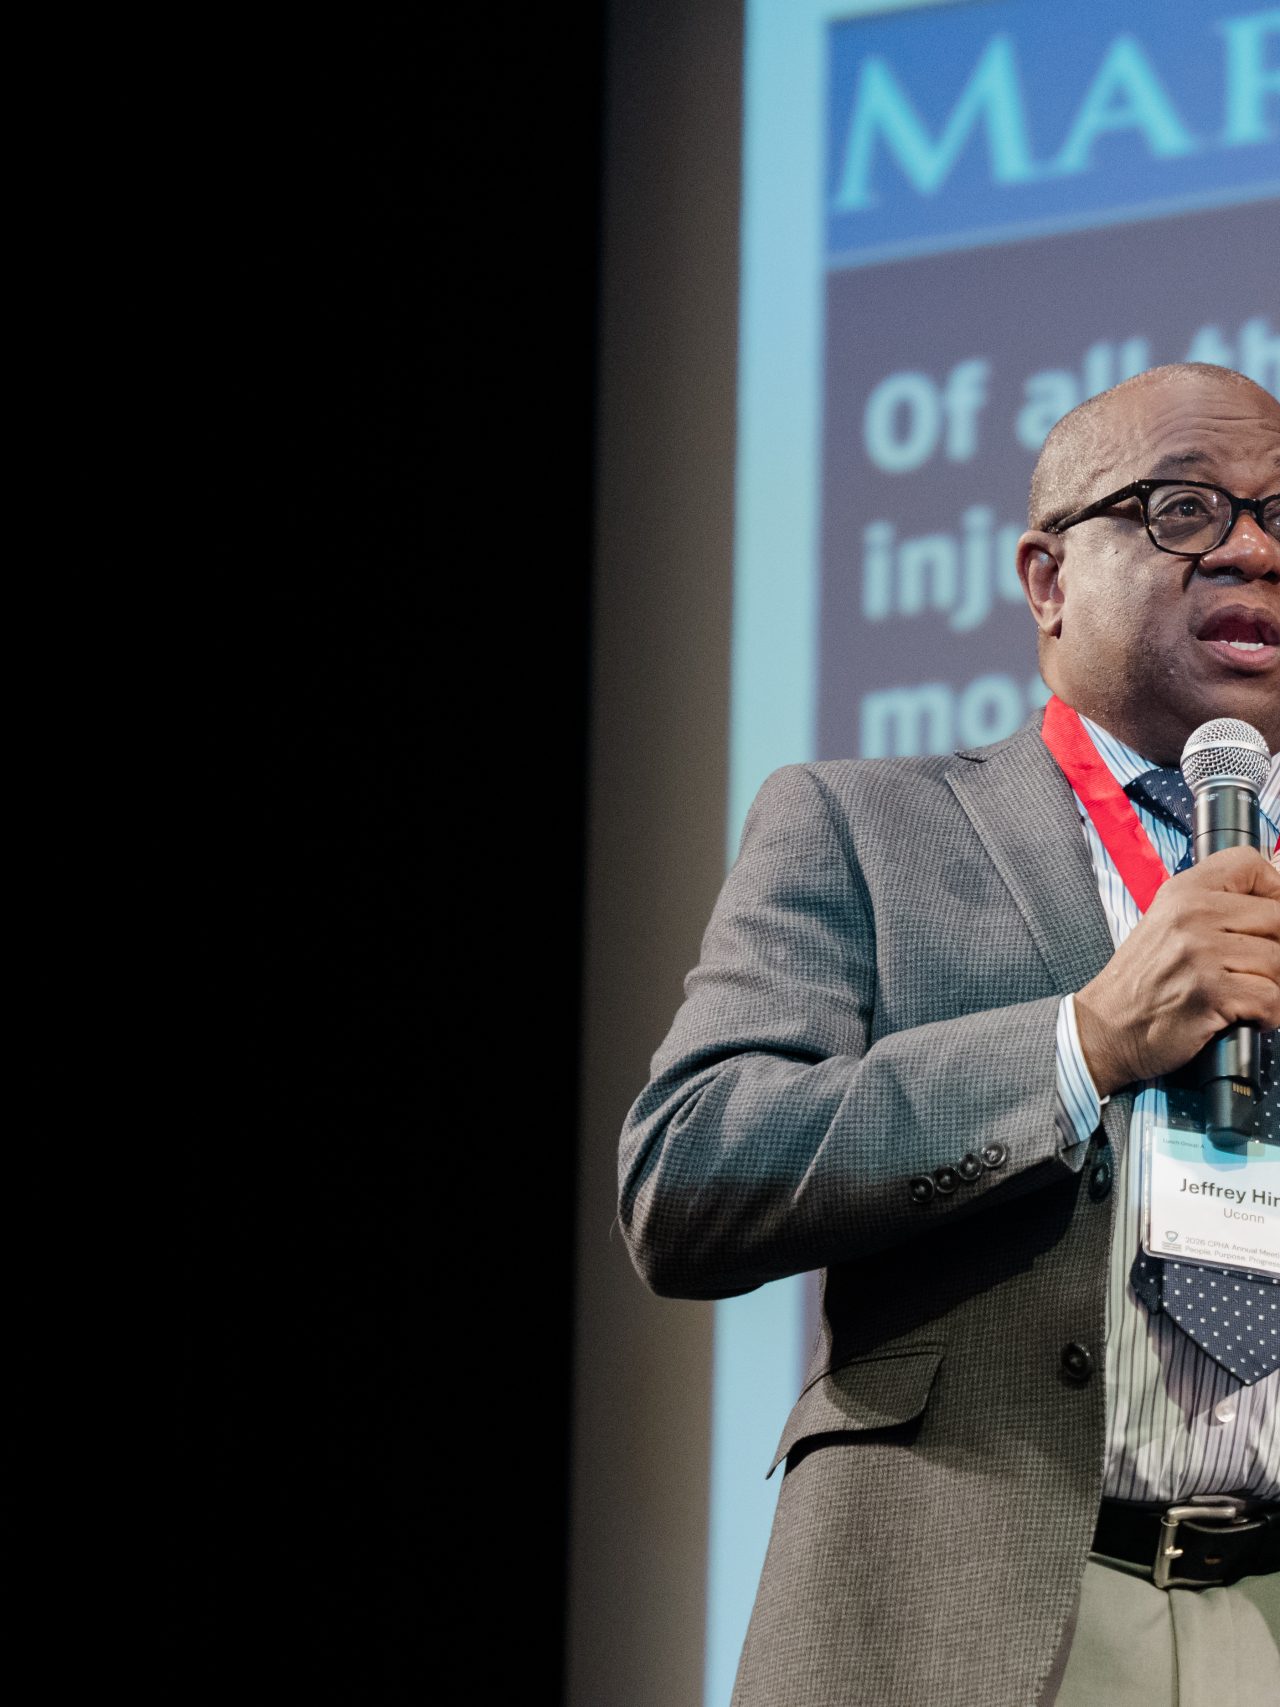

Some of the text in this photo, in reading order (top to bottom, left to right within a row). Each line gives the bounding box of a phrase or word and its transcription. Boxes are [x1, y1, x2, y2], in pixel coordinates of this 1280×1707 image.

[866, 360, 987, 473] Of
[861, 674, 1049, 759] mo
[1179, 1178, 1246, 1204] Jeffrey
[1223, 1207, 1265, 1224] Uconn
[1231, 1243, 1258, 1255] Annual
